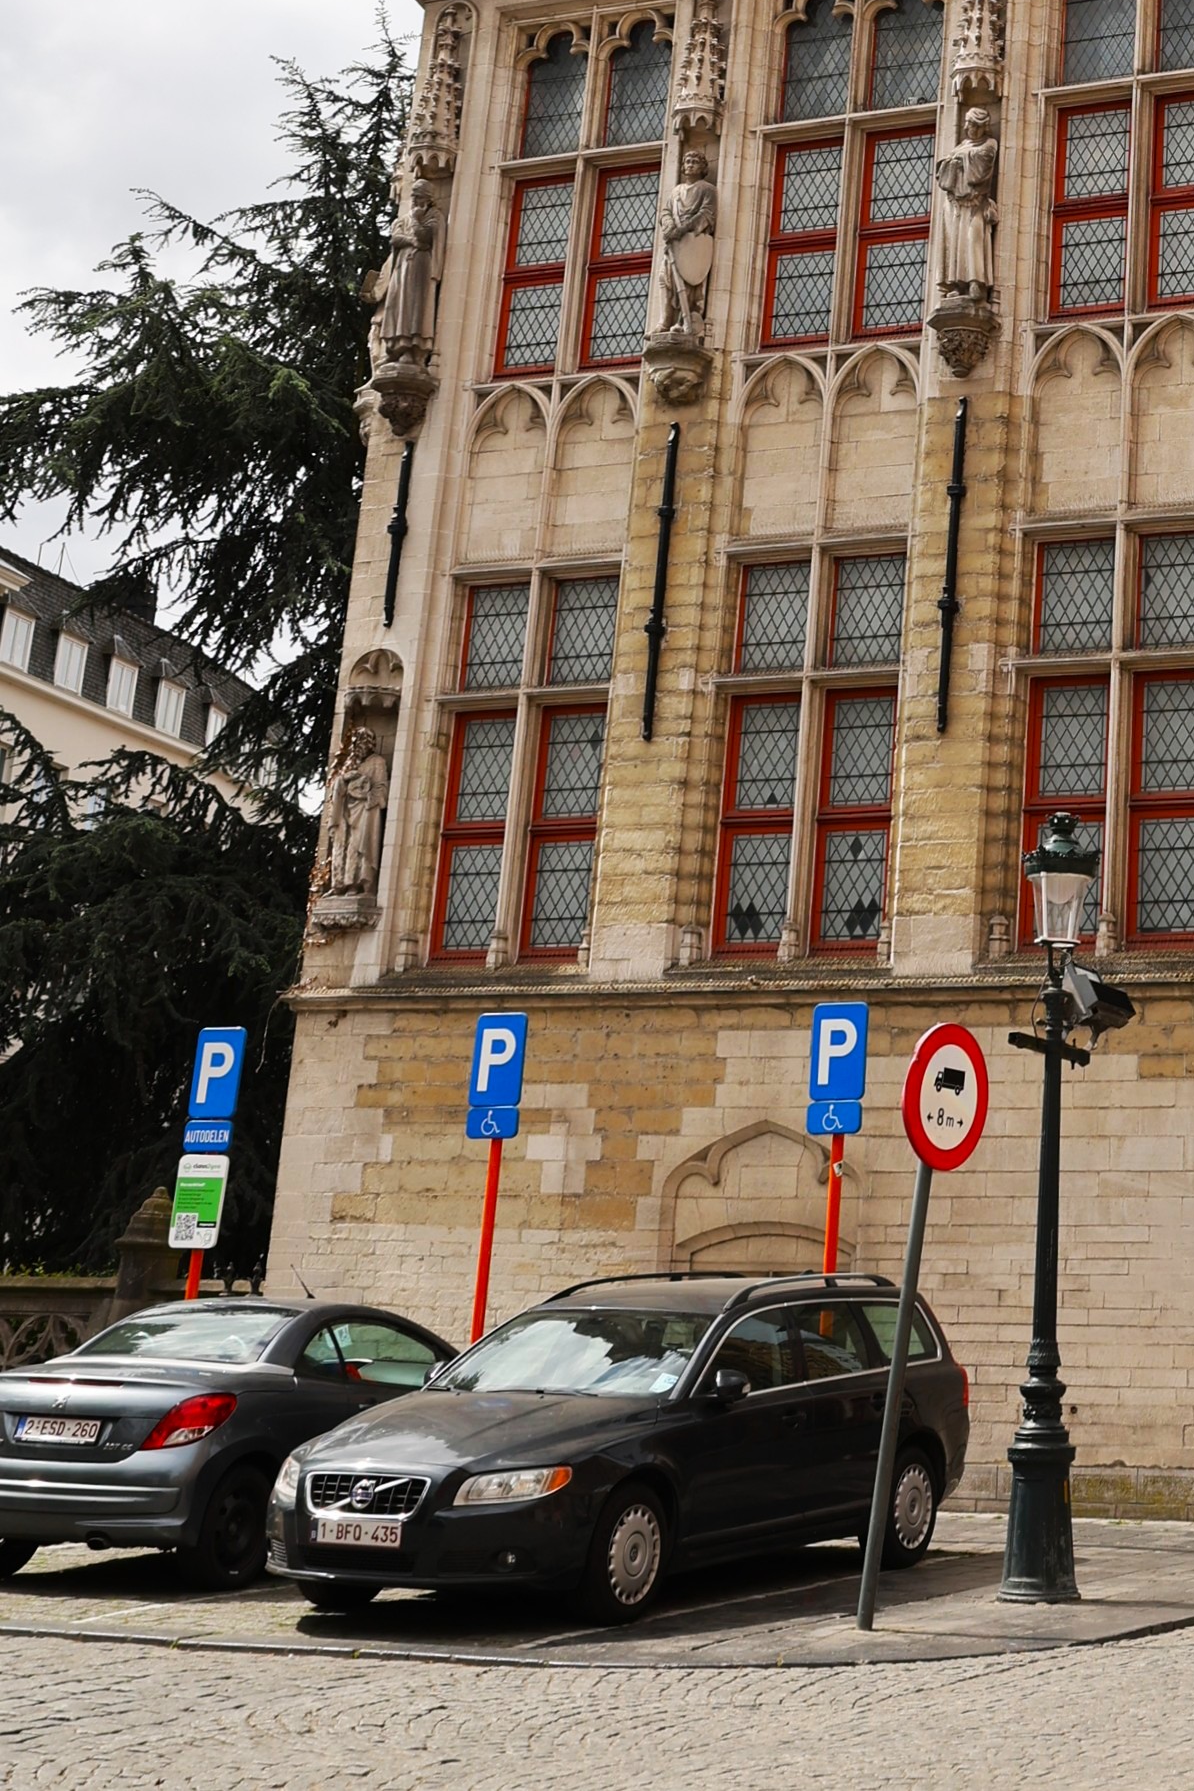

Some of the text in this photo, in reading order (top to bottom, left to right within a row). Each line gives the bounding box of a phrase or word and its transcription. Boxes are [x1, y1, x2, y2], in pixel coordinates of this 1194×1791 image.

[195, 1042, 235, 1104] P
[476, 1028, 516, 1092] P
[817, 1018, 858, 1086] P
[184, 1130, 230, 1143] AUTODELEN
[936, 1108, 955, 1127] 8 m
